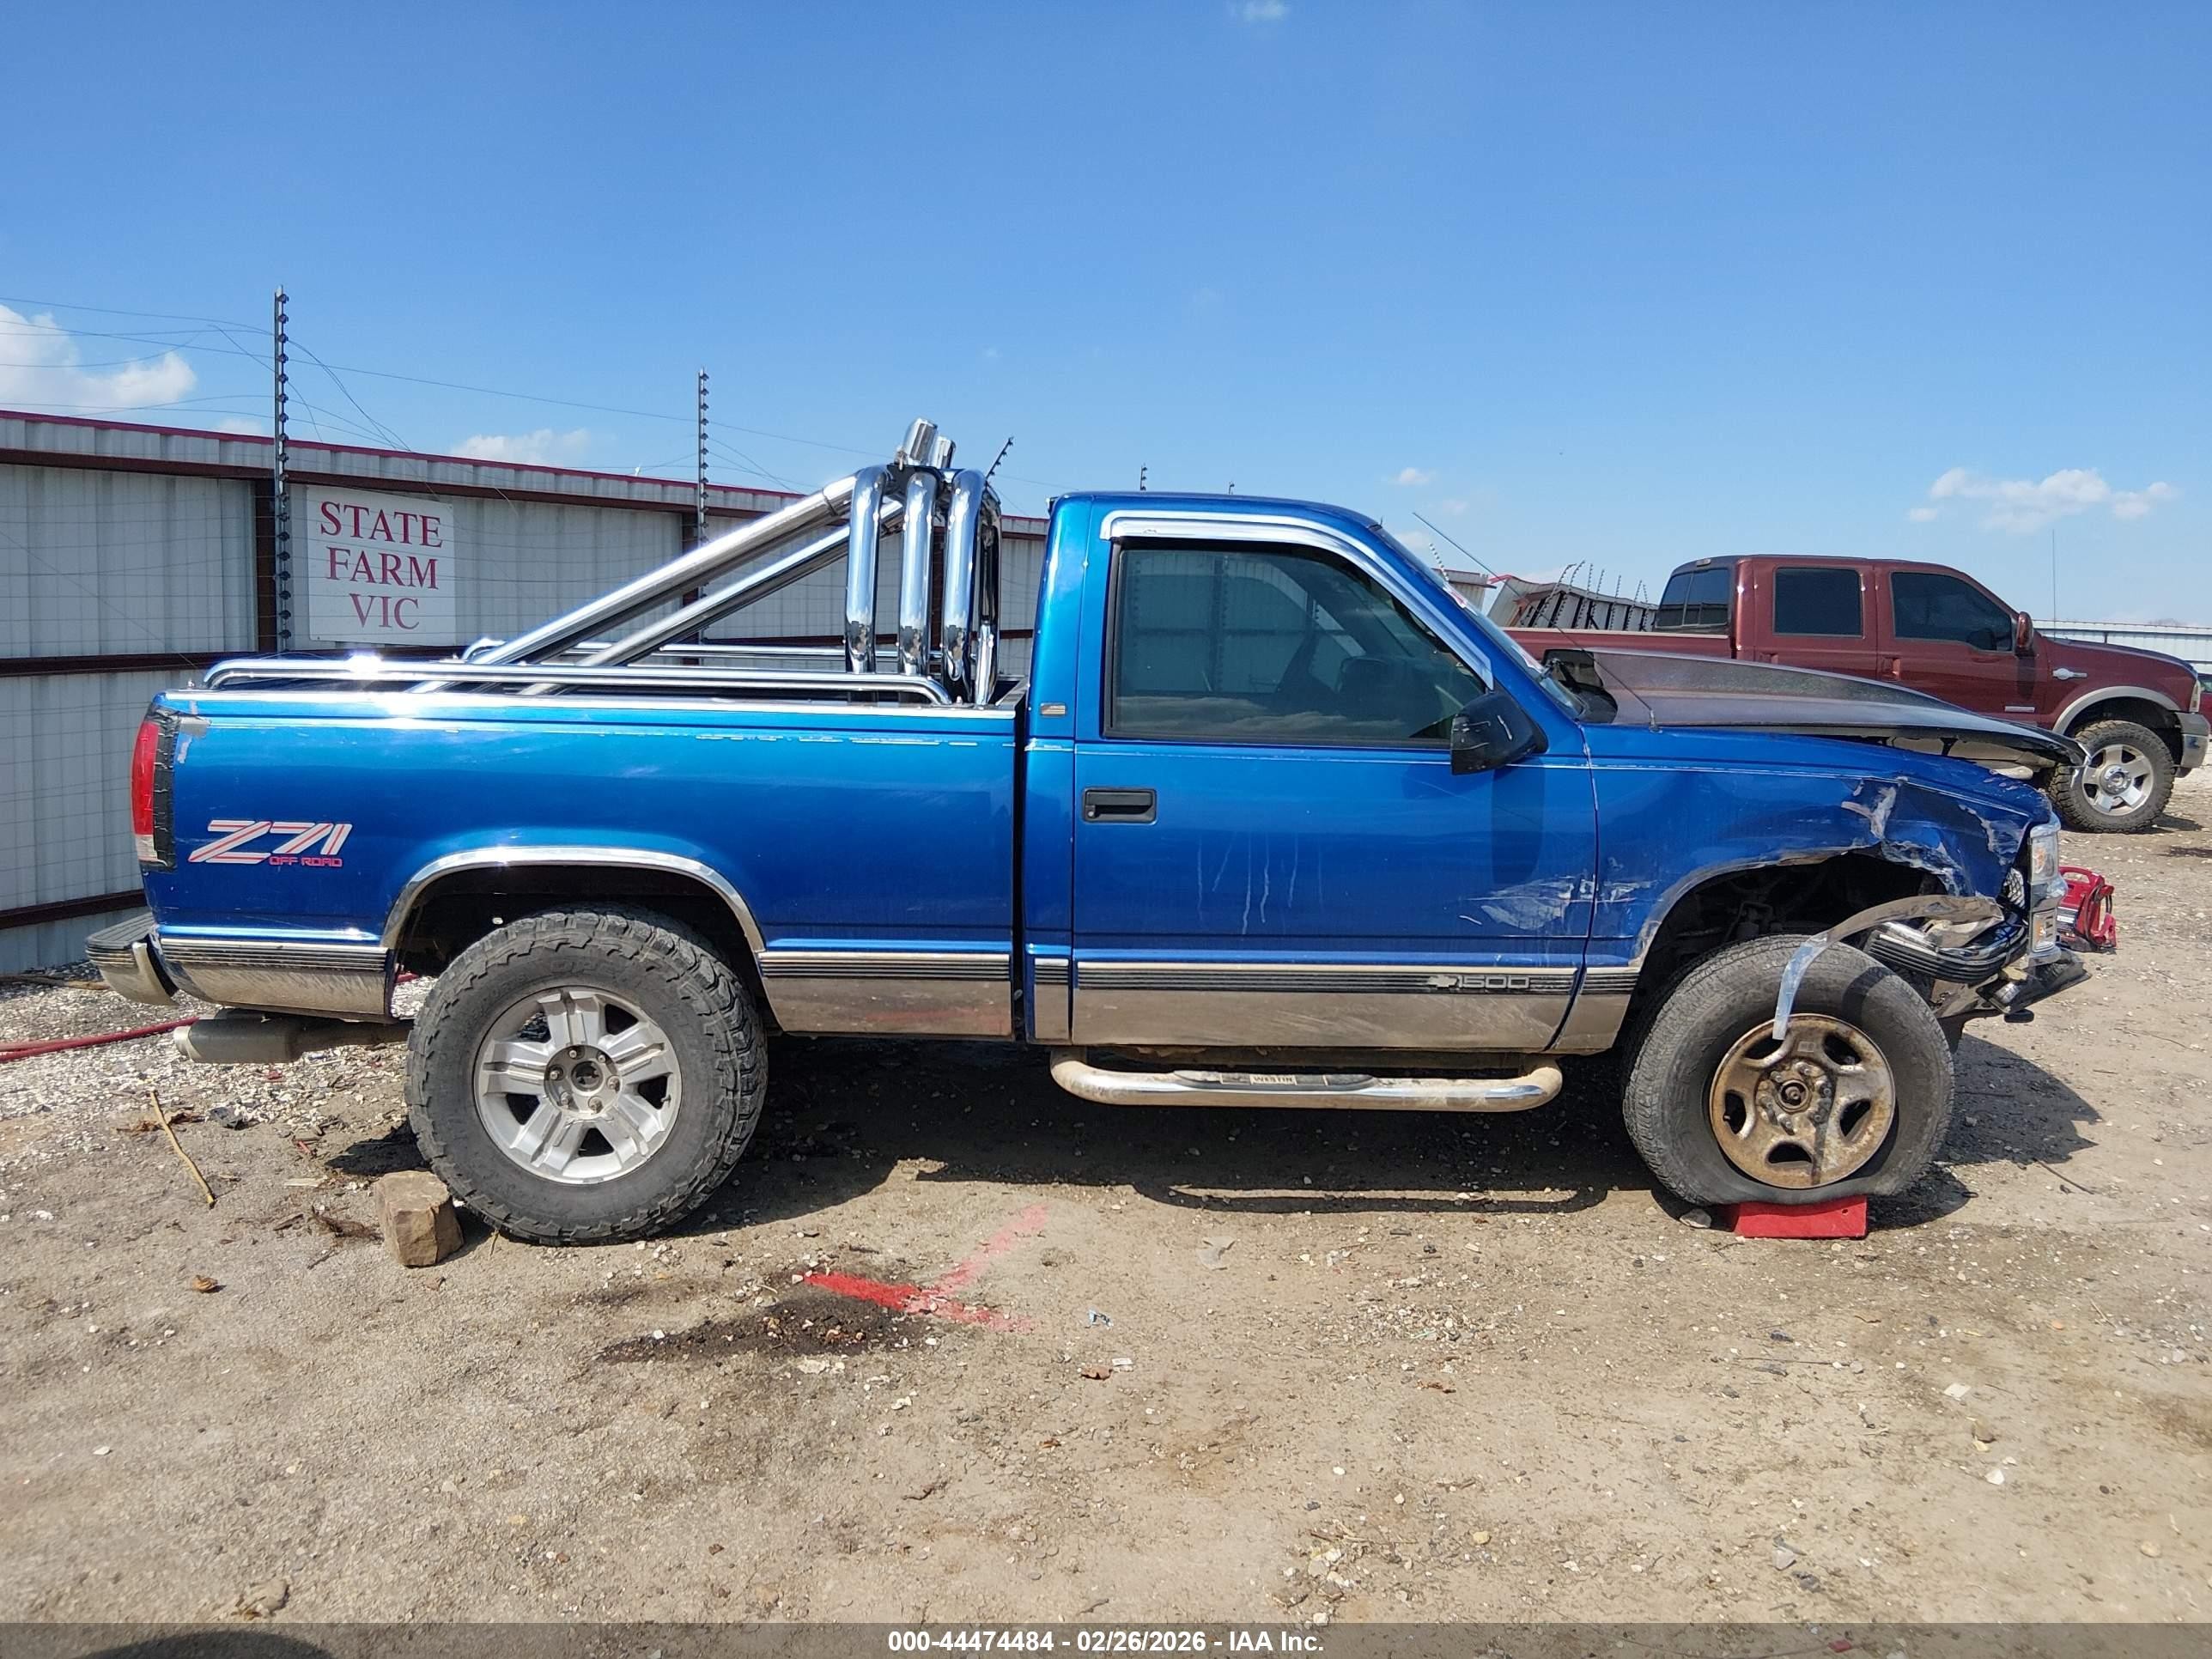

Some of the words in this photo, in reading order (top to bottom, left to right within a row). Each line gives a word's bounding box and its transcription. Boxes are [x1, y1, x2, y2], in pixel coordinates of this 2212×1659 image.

[320, 501, 443, 549] STATE
[325, 545, 439, 590] FARM
[349, 592, 420, 630] VIC
[187, 819, 353, 865] Z71
[269, 856, 299, 866] OFF
[301, 856, 343, 867] ROAD
[1456, 975, 1530, 988] 1500
